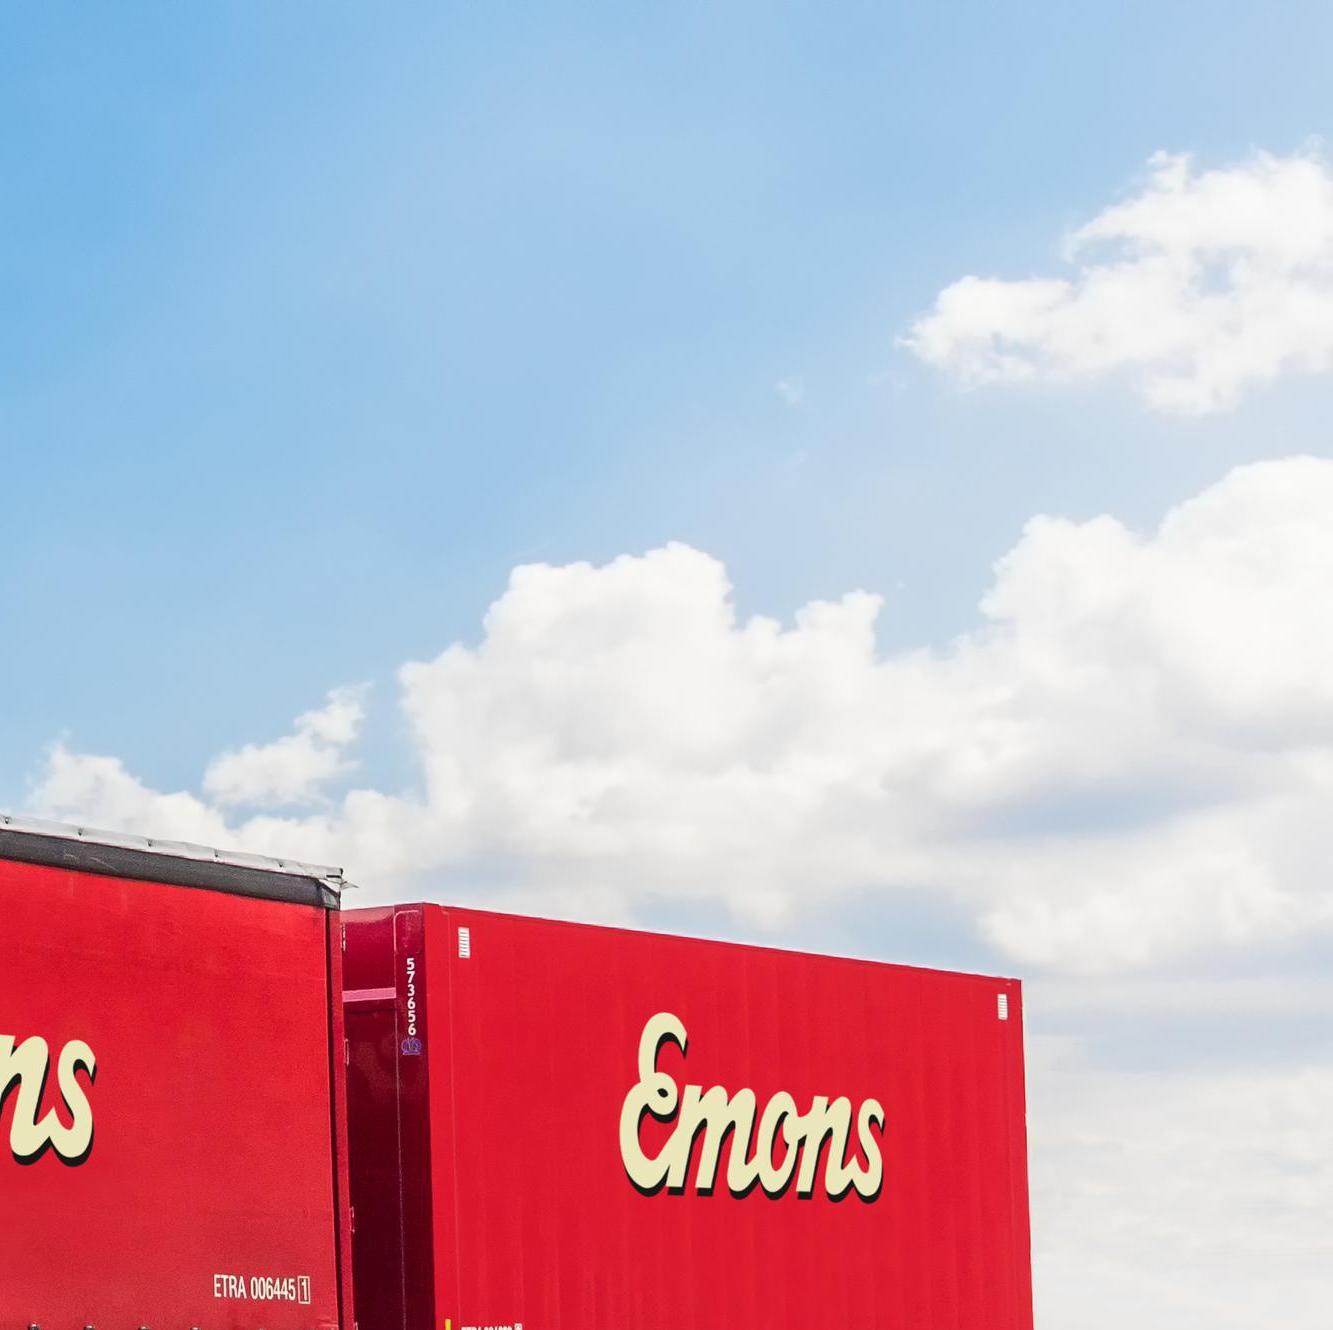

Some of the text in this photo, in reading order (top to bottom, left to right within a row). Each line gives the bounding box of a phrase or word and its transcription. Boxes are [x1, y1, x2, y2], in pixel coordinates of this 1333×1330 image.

[406, 957, 417, 1036] 573656
[619, 1012, 885, 1203] Emons
[214, 1274, 248, 1299] ETRA
[250, 1276, 296, 1301] 006445
